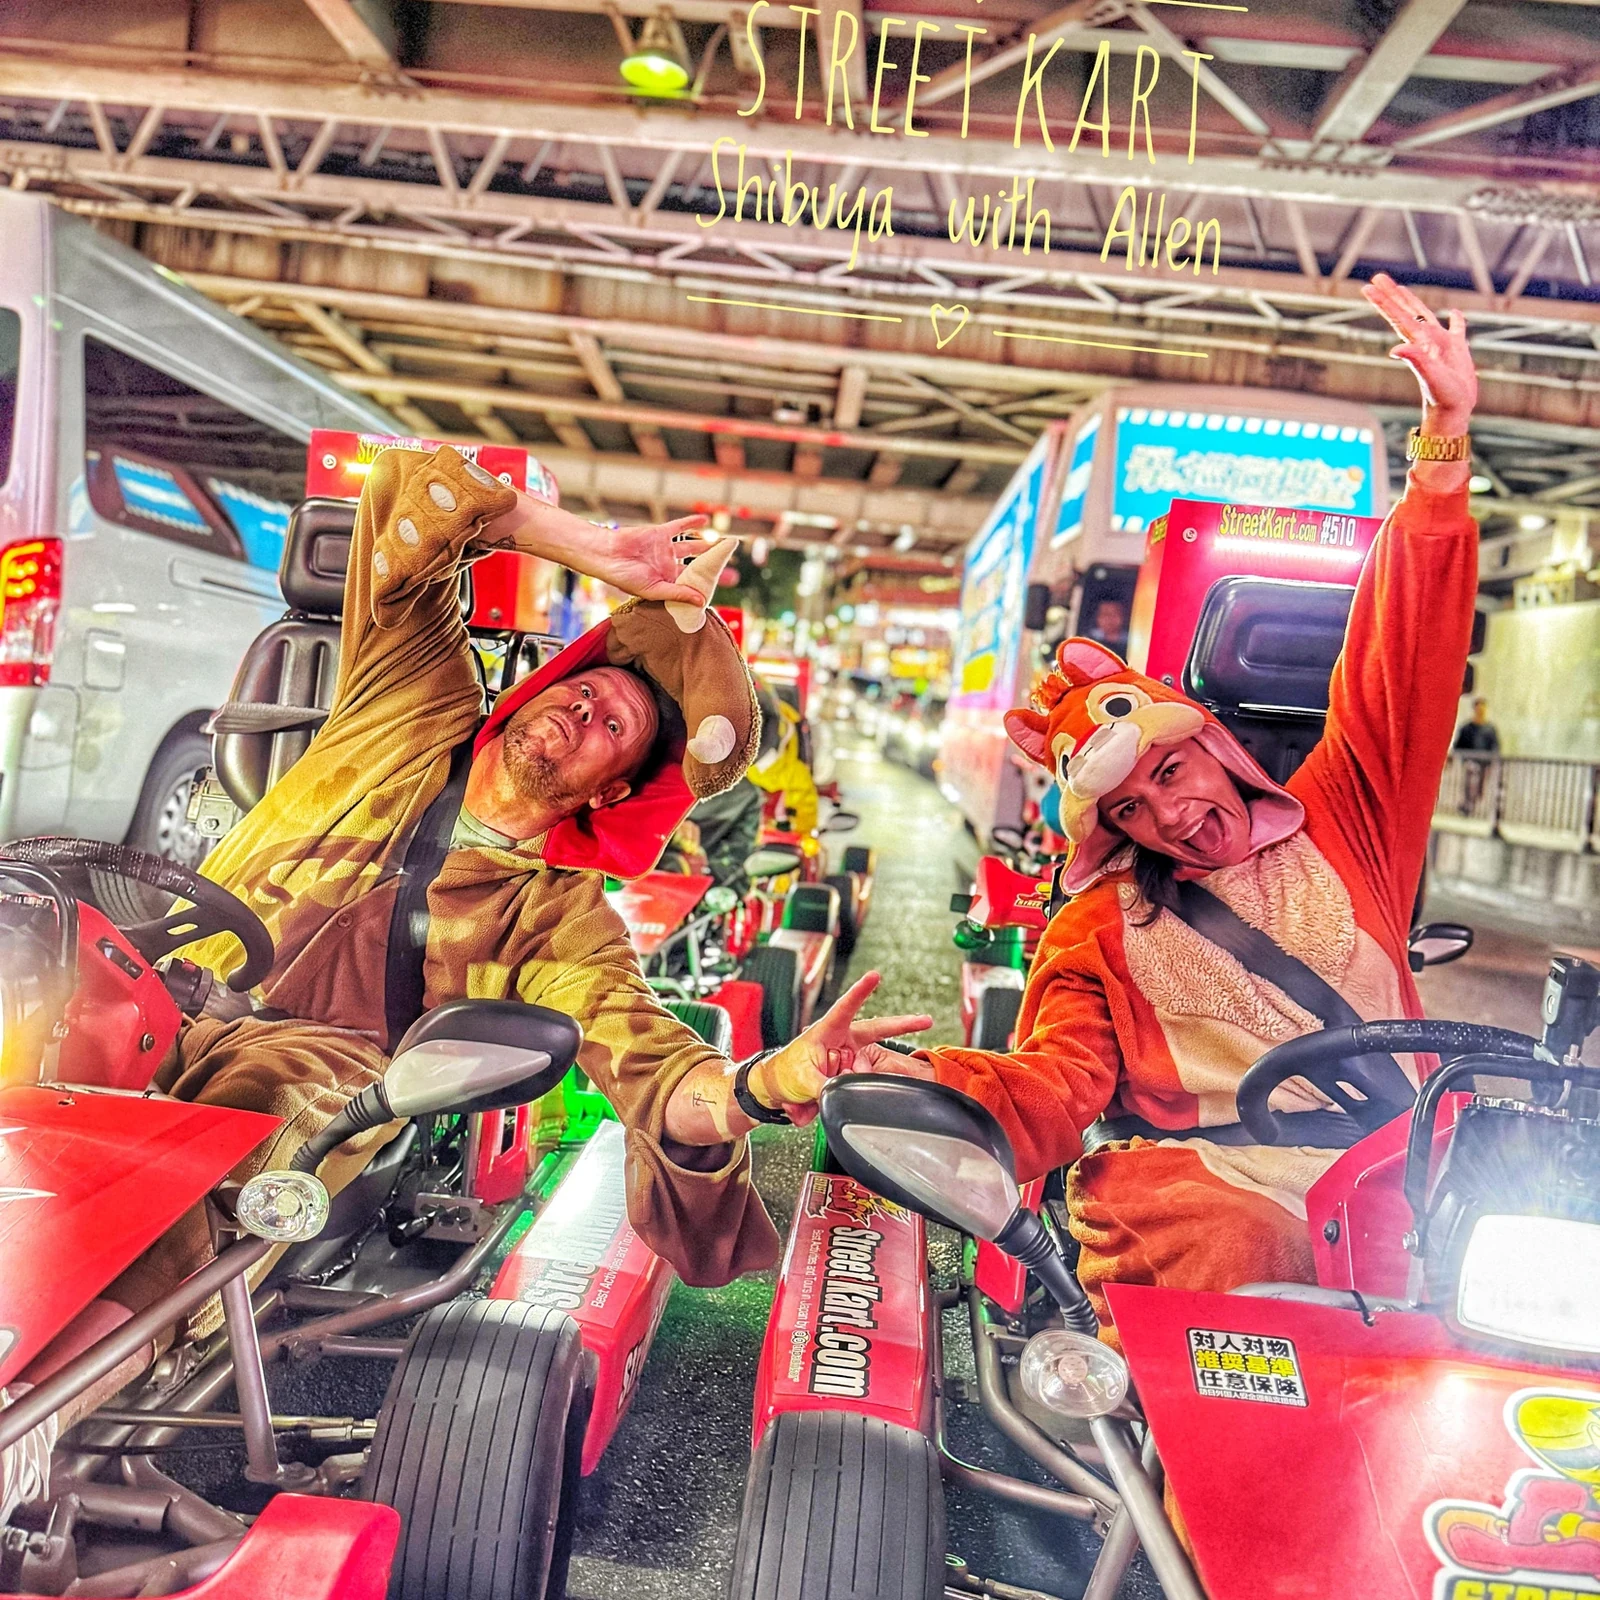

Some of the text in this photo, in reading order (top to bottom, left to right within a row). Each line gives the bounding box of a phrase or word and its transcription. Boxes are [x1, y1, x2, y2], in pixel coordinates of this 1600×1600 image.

[1220, 504, 1356, 547] StreetKart.com #510
[590, 1289, 609, 1309] Best
[600, 1256, 624, 1290] Activities
[616, 1244, 629, 1259] and
[805, 1265, 817, 1276] and
[801, 1276, 817, 1293] Tours
[797, 1300, 812, 1320] Japan
[1193, 1332, 1290, 1357] 対人対物
[1195, 1349, 1297, 1377] 推奨基準
[1199, 1370, 1299, 1396] 任意保険
